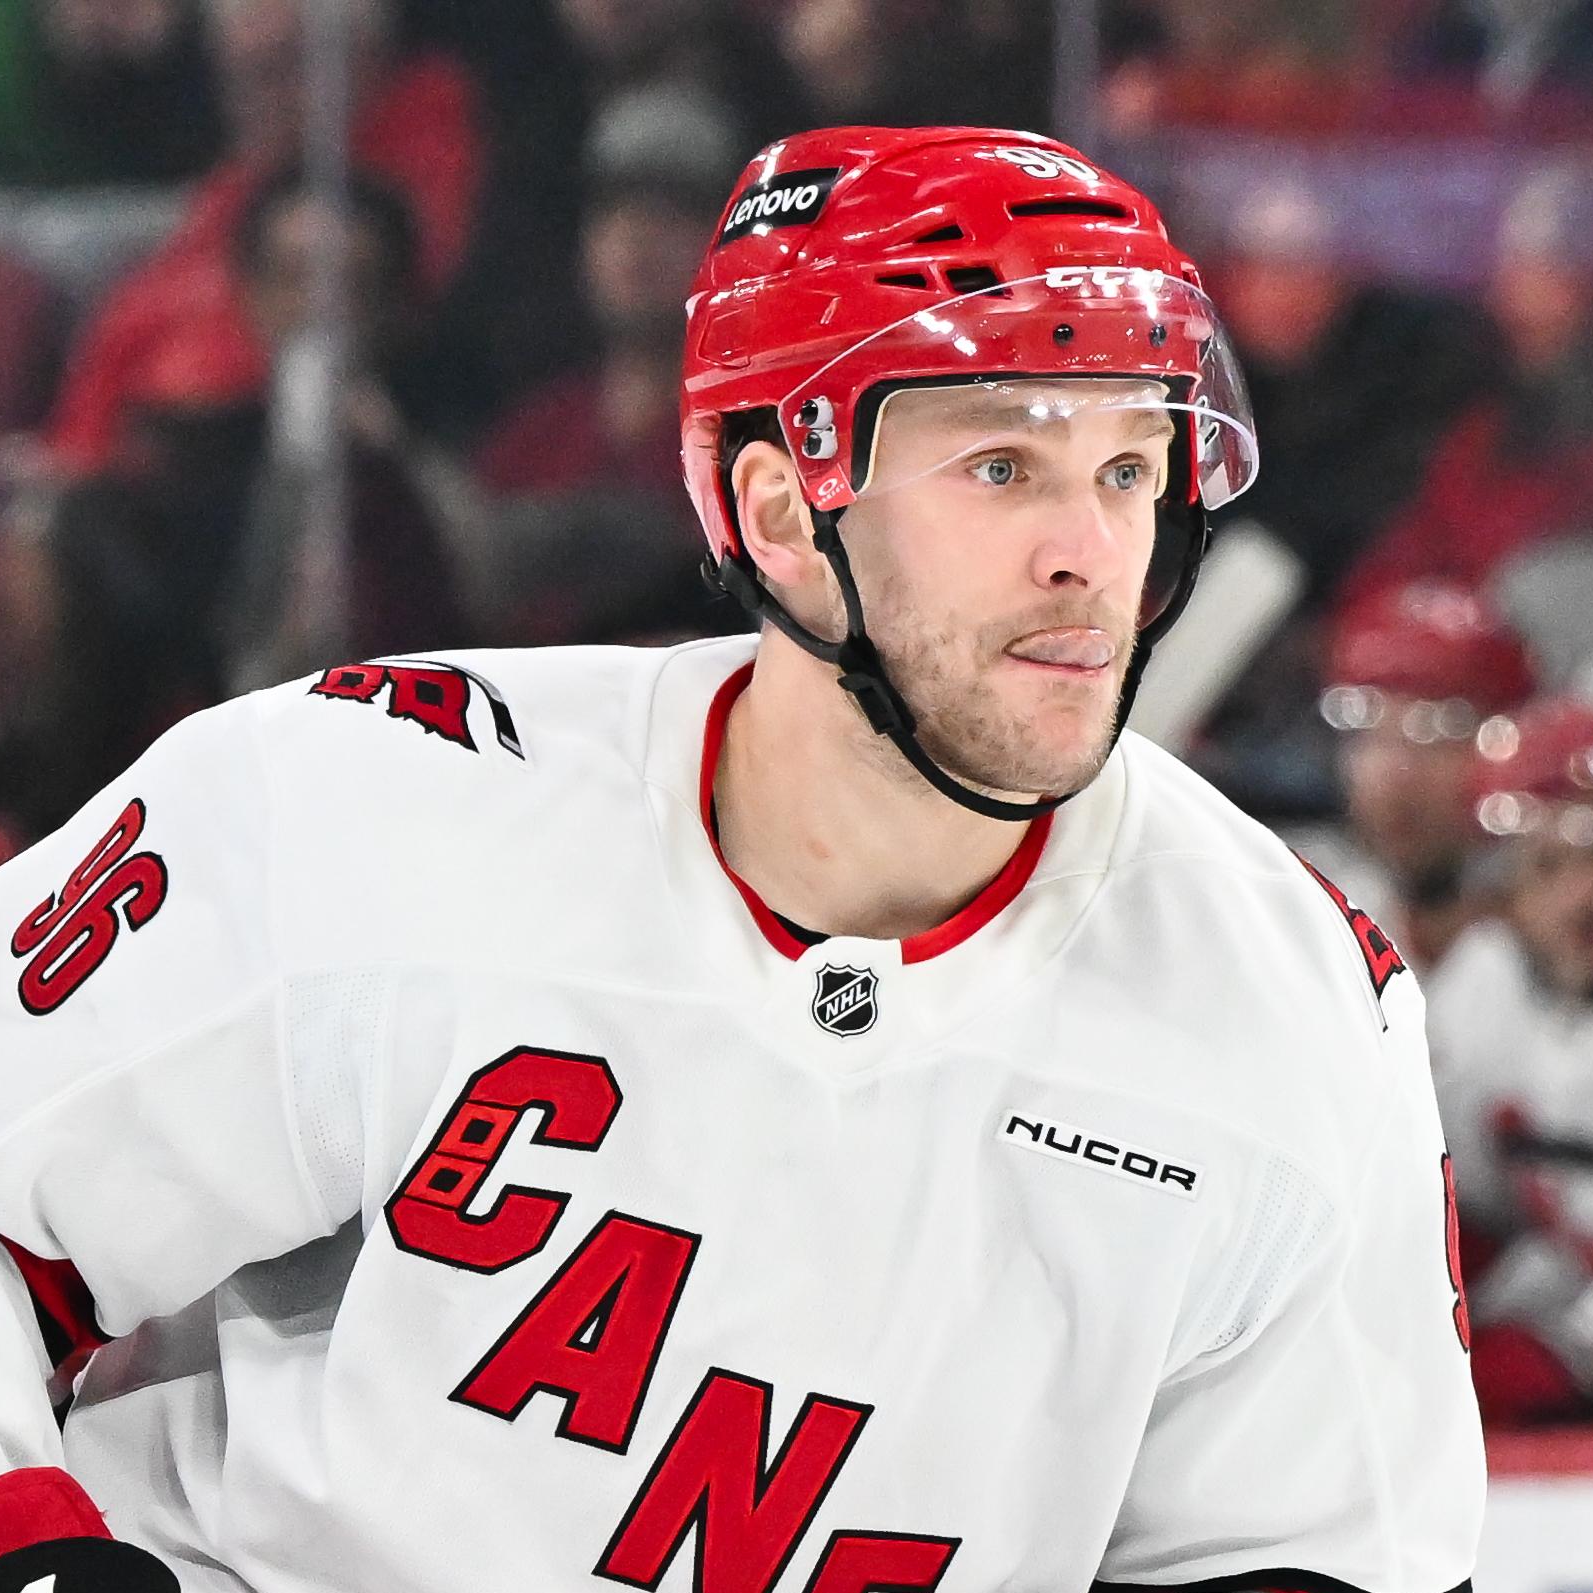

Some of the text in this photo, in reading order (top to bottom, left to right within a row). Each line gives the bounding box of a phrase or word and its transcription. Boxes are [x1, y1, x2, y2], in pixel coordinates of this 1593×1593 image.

[724, 185, 819, 232] Lenovo
[10, 797, 169, 1017] 96
[825, 982, 868, 1022] NHL
[1006, 1114, 1197, 1192] NUCOR
